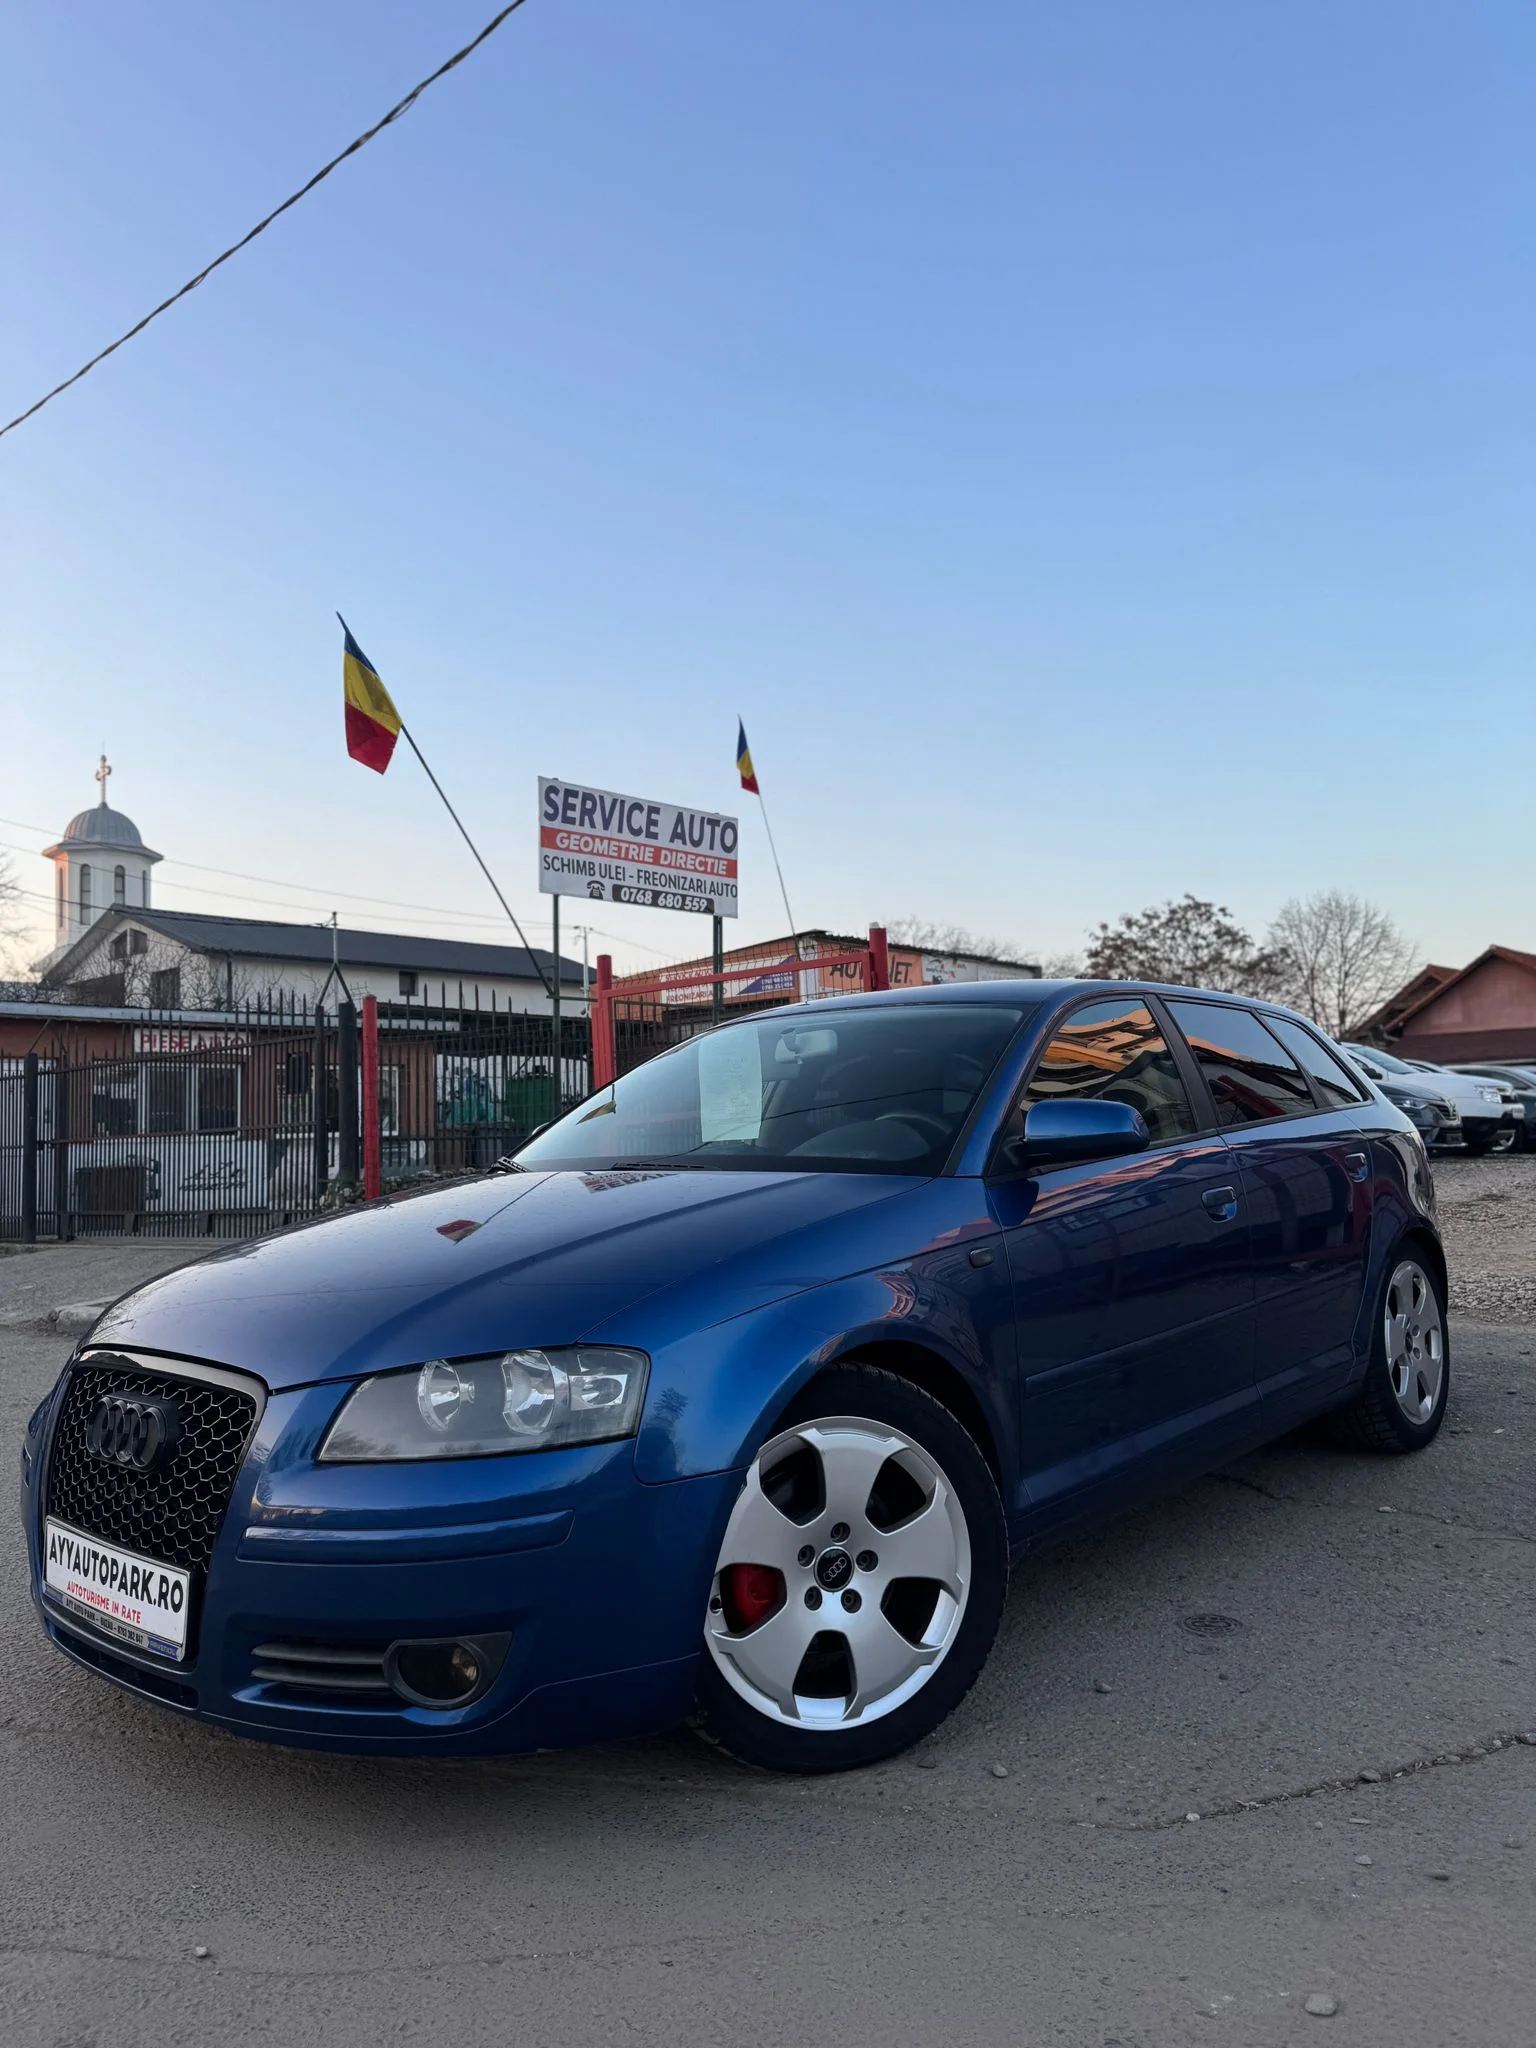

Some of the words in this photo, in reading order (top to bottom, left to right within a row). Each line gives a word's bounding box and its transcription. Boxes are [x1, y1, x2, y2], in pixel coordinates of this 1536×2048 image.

[543, 784, 661, 840] SERVICE
[669, 811, 738, 854] AUTO
[556, 832, 654, 865] GEOMETRIE
[660, 850, 728, 875] DIRECTIE
[543, 854, 596, 877] SCHIMB
[599, 862, 626, 882] ULEI
[637, 869, 707, 894] FREONIZARI
[709, 882, 738, 898] AUTO
[620, 887, 653, 904] 0768
[658, 894, 682, 909] 680
[684, 897, 708, 912] 559
[143, 1033, 189, 1050] PIESE
[49, 1533, 184, 1614] AYYAUTOPARK.RO
[66, 1580, 110, 1610] AUTOTURISME
[112, 1601, 120, 1614] IN
[121, 1606, 142, 1625] RATE
[84, 1607, 96, 1621] PARK
